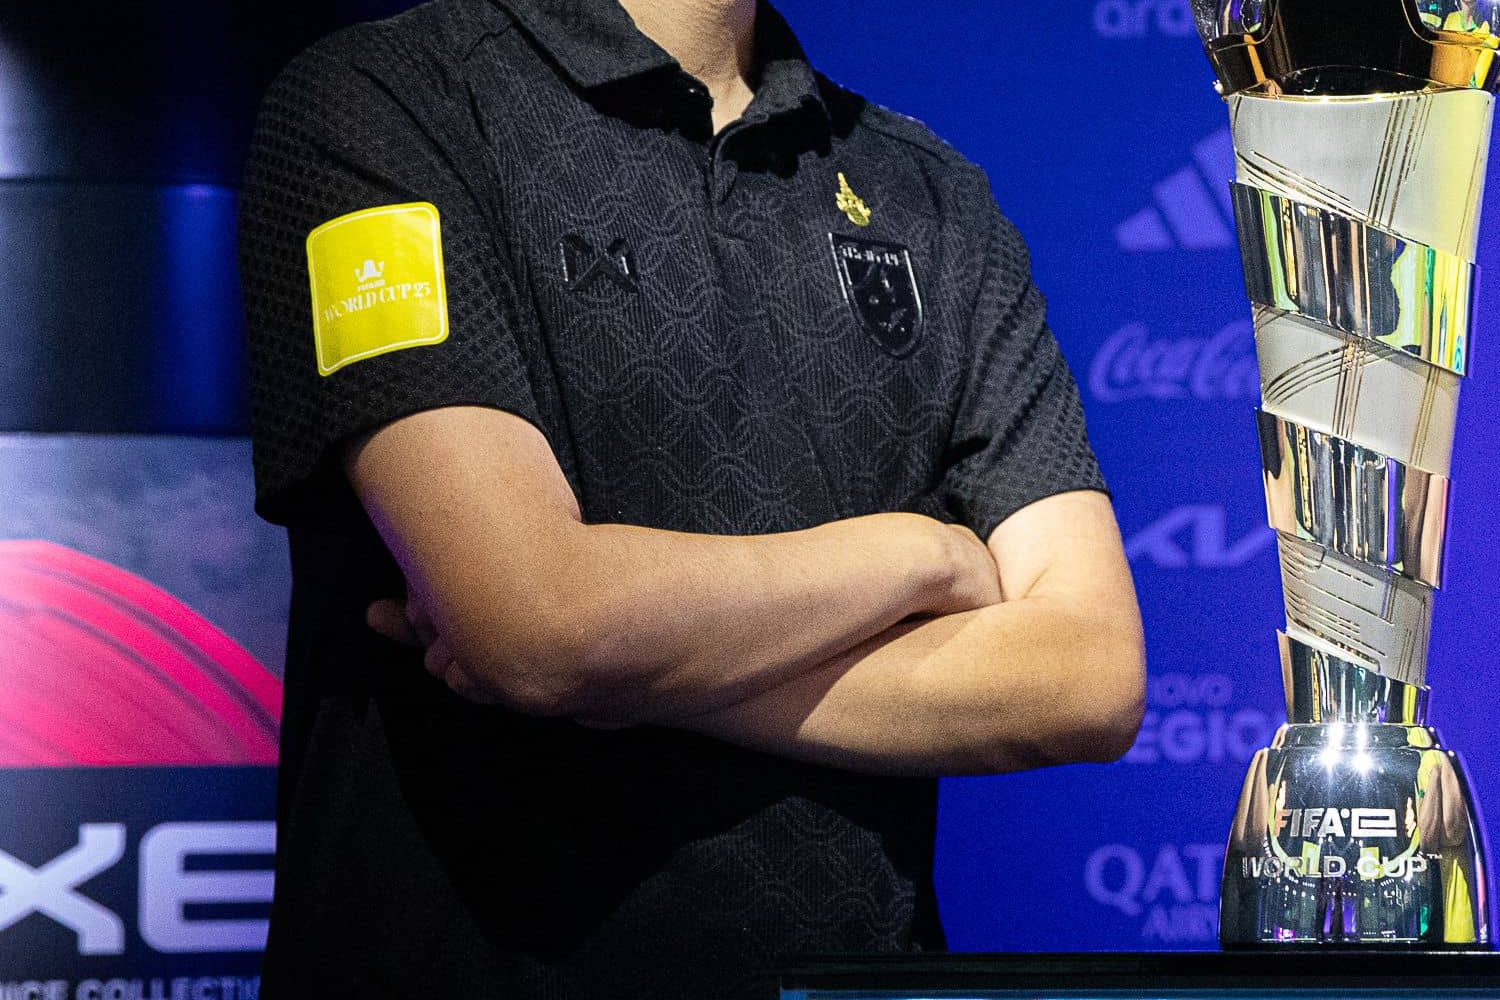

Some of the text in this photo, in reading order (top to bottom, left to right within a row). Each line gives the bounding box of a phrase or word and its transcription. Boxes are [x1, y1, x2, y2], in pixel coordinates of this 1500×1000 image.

[0, 821, 277, 955] XE
[1084, 843, 1222, 917] QAT
[1242, 856, 1347, 879] WORLD
